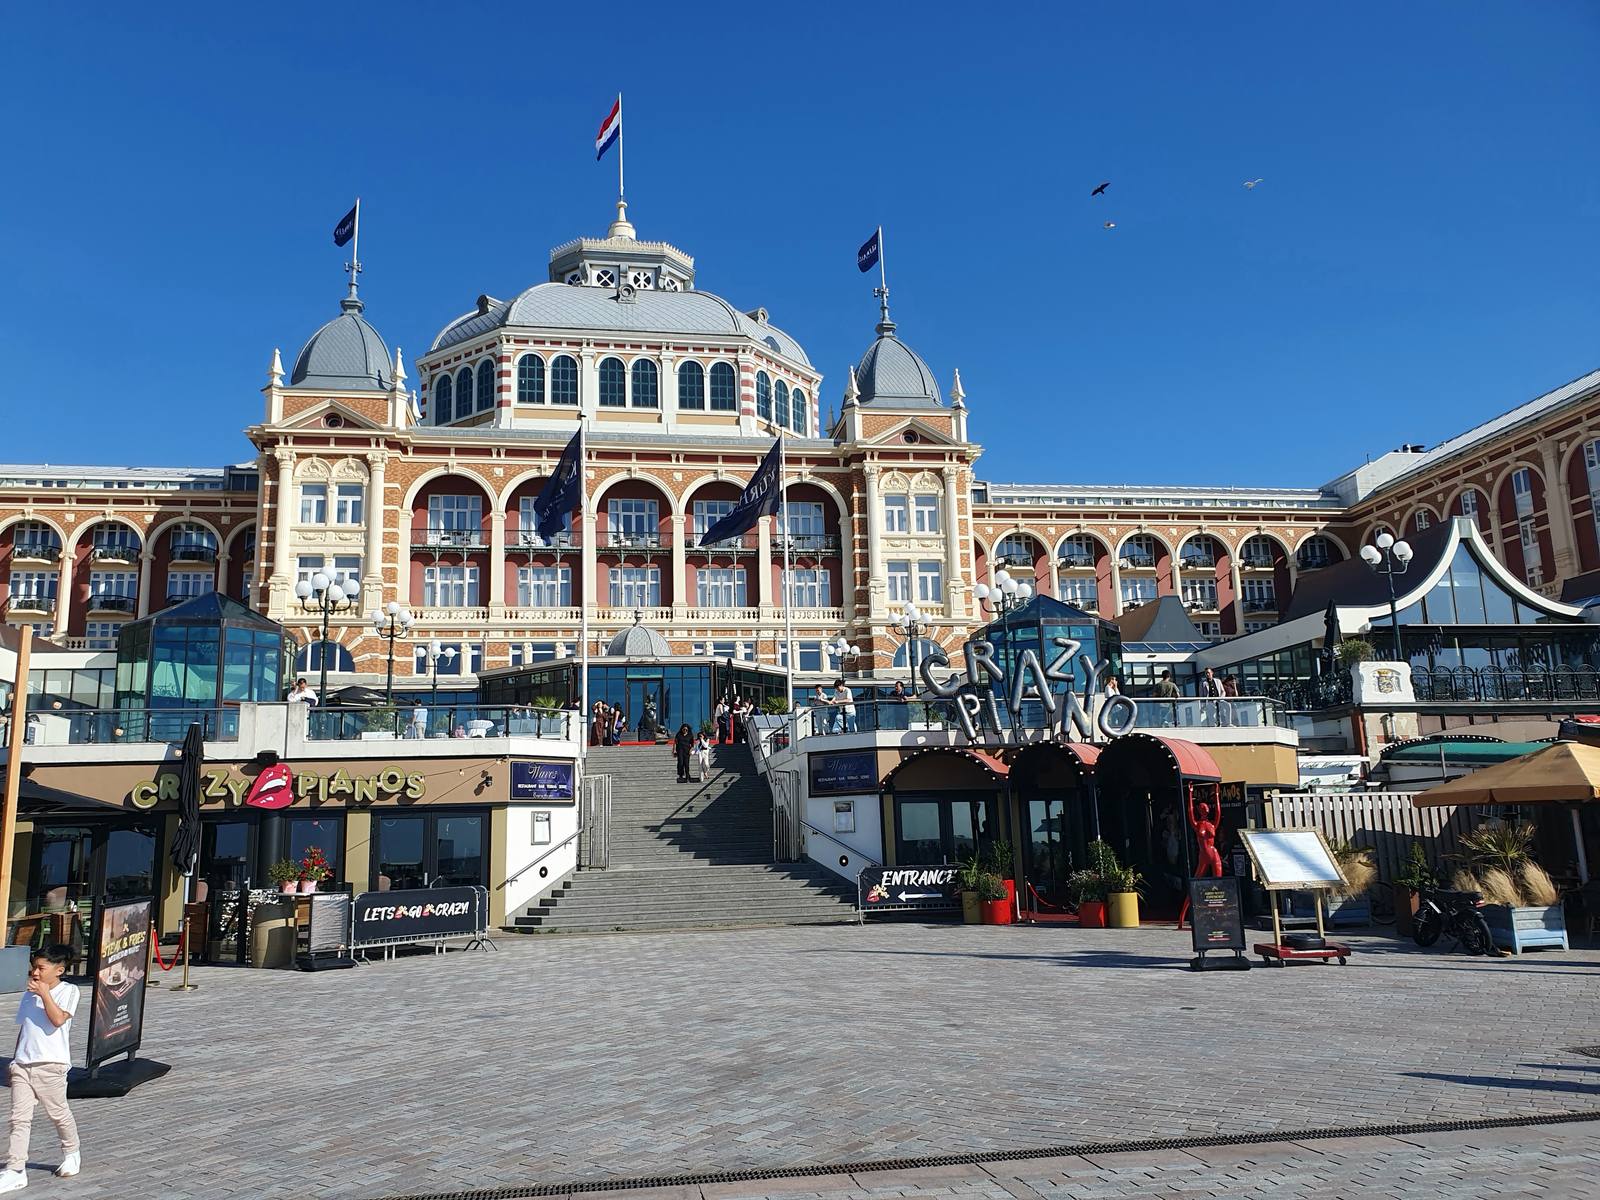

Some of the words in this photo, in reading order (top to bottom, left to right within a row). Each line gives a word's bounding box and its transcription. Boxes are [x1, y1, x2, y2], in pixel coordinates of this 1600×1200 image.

[918, 636, 1109, 713] CRAZY
[131, 769, 250, 809] CRZY
[298, 765, 426, 802] PIANOS
[881, 869, 958, 887] ENTRANCE
[363, 906, 396, 922] LETS
[408, 905, 423, 919] GO
[434, 901, 470, 917] CRAZY!
[101, 938, 123, 958] STEAK
[122, 936, 129, 949] &
[129, 930, 147, 947] FRIES
